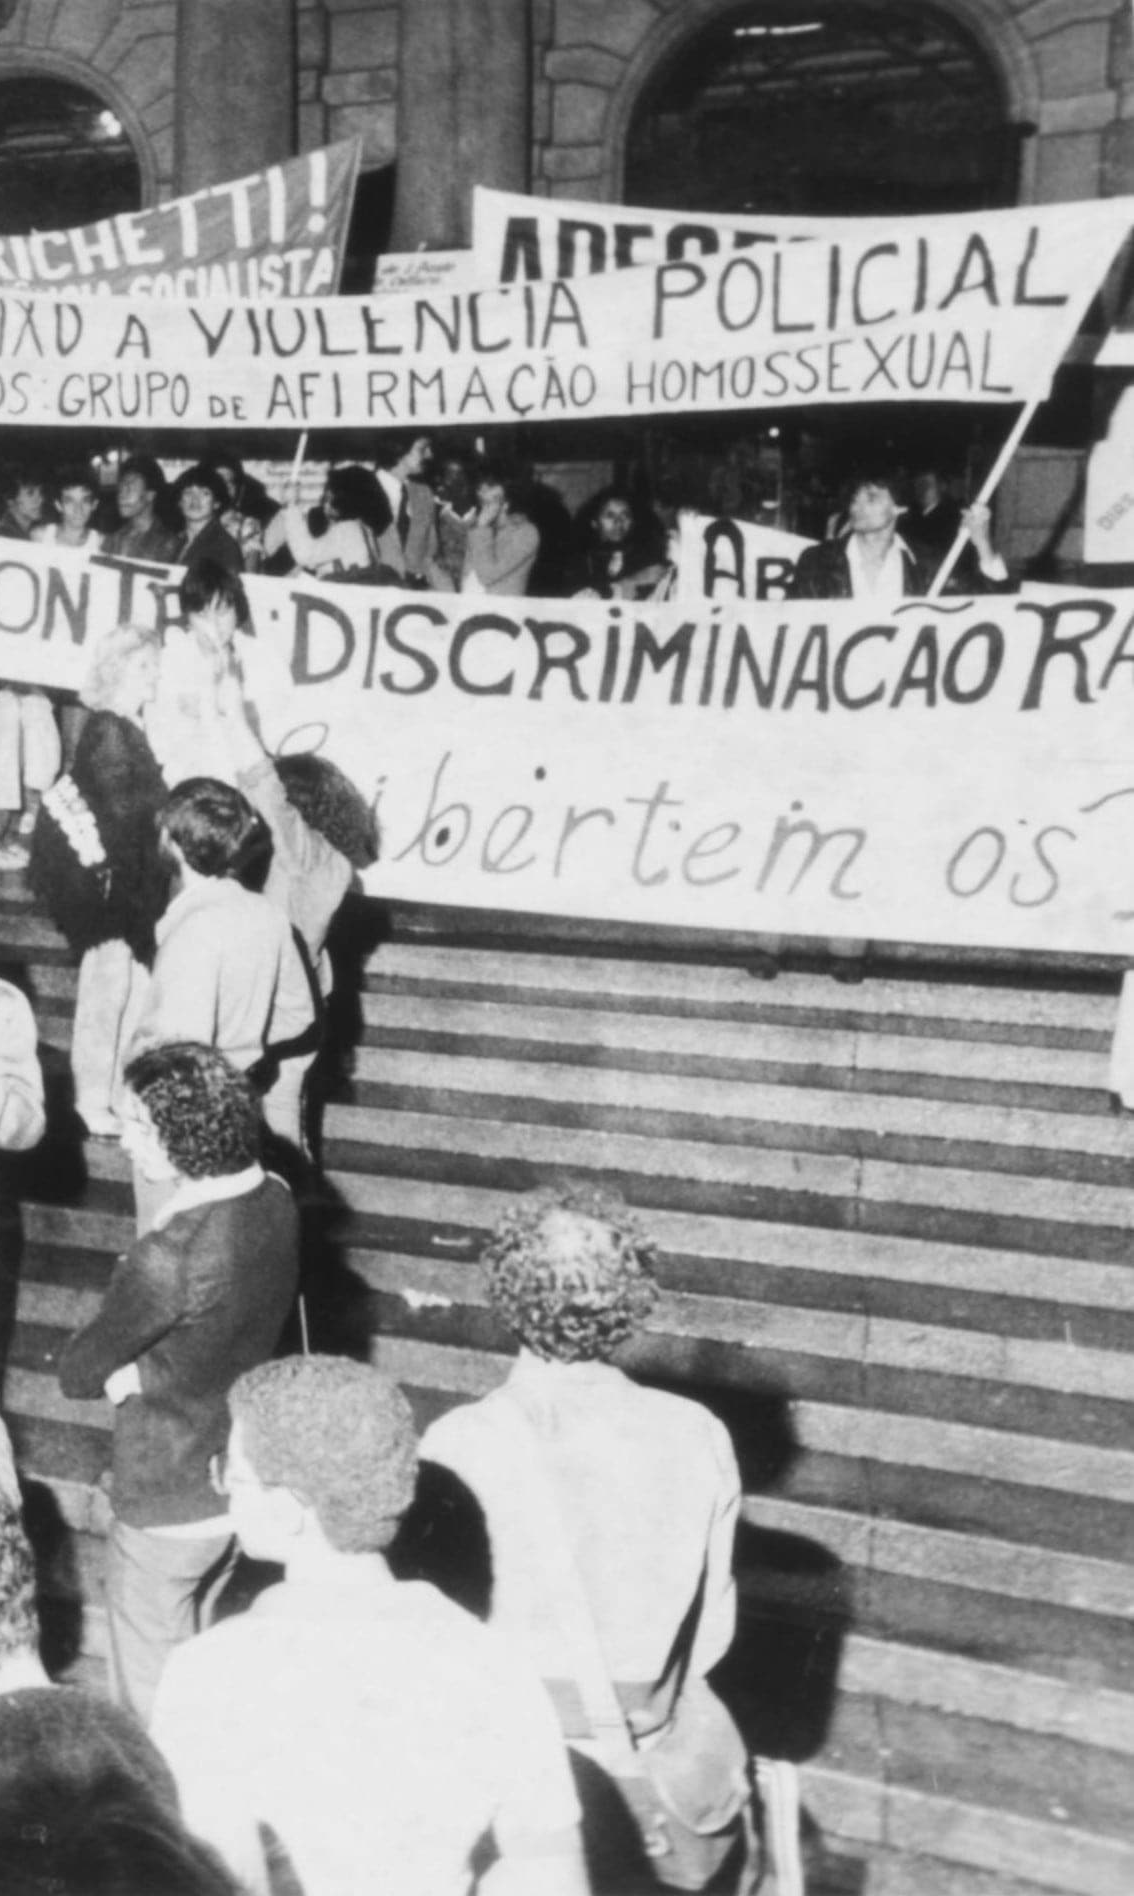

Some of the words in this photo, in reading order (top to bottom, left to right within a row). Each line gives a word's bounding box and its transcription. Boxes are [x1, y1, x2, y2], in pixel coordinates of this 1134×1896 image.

[115, 312, 154, 358] A
[654, 225, 1069, 340] POLICIAL
[58, 371, 189, 418] GRUPO
[208, 395, 248, 421] DE
[267, 357, 596, 419] AFIRMAÇÃO
[627, 329, 1014, 402] HOMOSSEXUAL
[275, 720, 867, 901] ibertem
